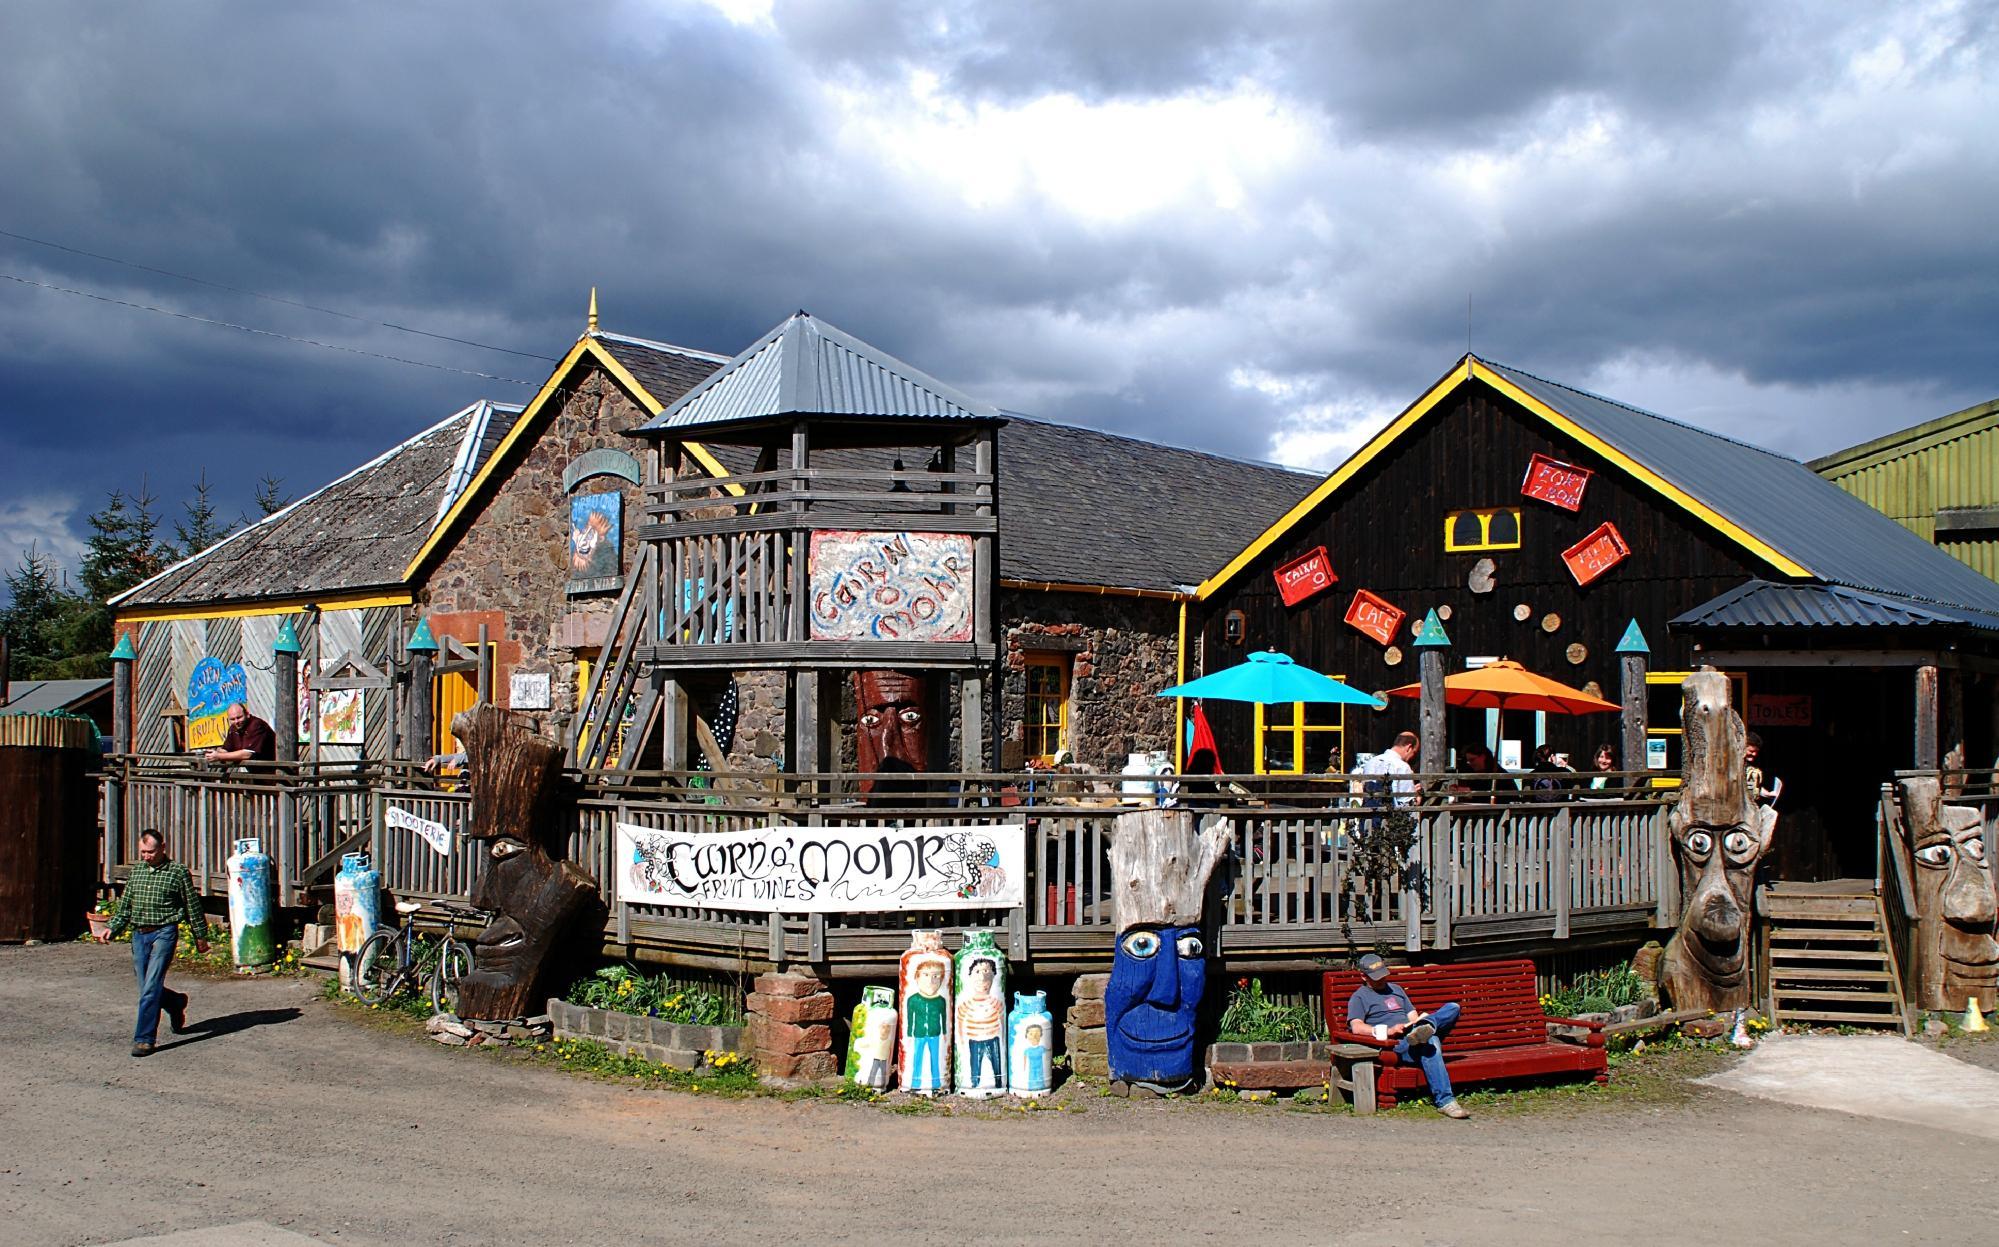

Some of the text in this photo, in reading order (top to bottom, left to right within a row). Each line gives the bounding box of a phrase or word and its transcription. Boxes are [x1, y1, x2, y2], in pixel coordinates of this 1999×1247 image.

[1285, 559, 1319, 583] CAIRN
[1754, 702, 1809, 720] TOILETS
[193, 717, 216, 743] FRUIT
[702, 876, 819, 901] FRUIT WINES
